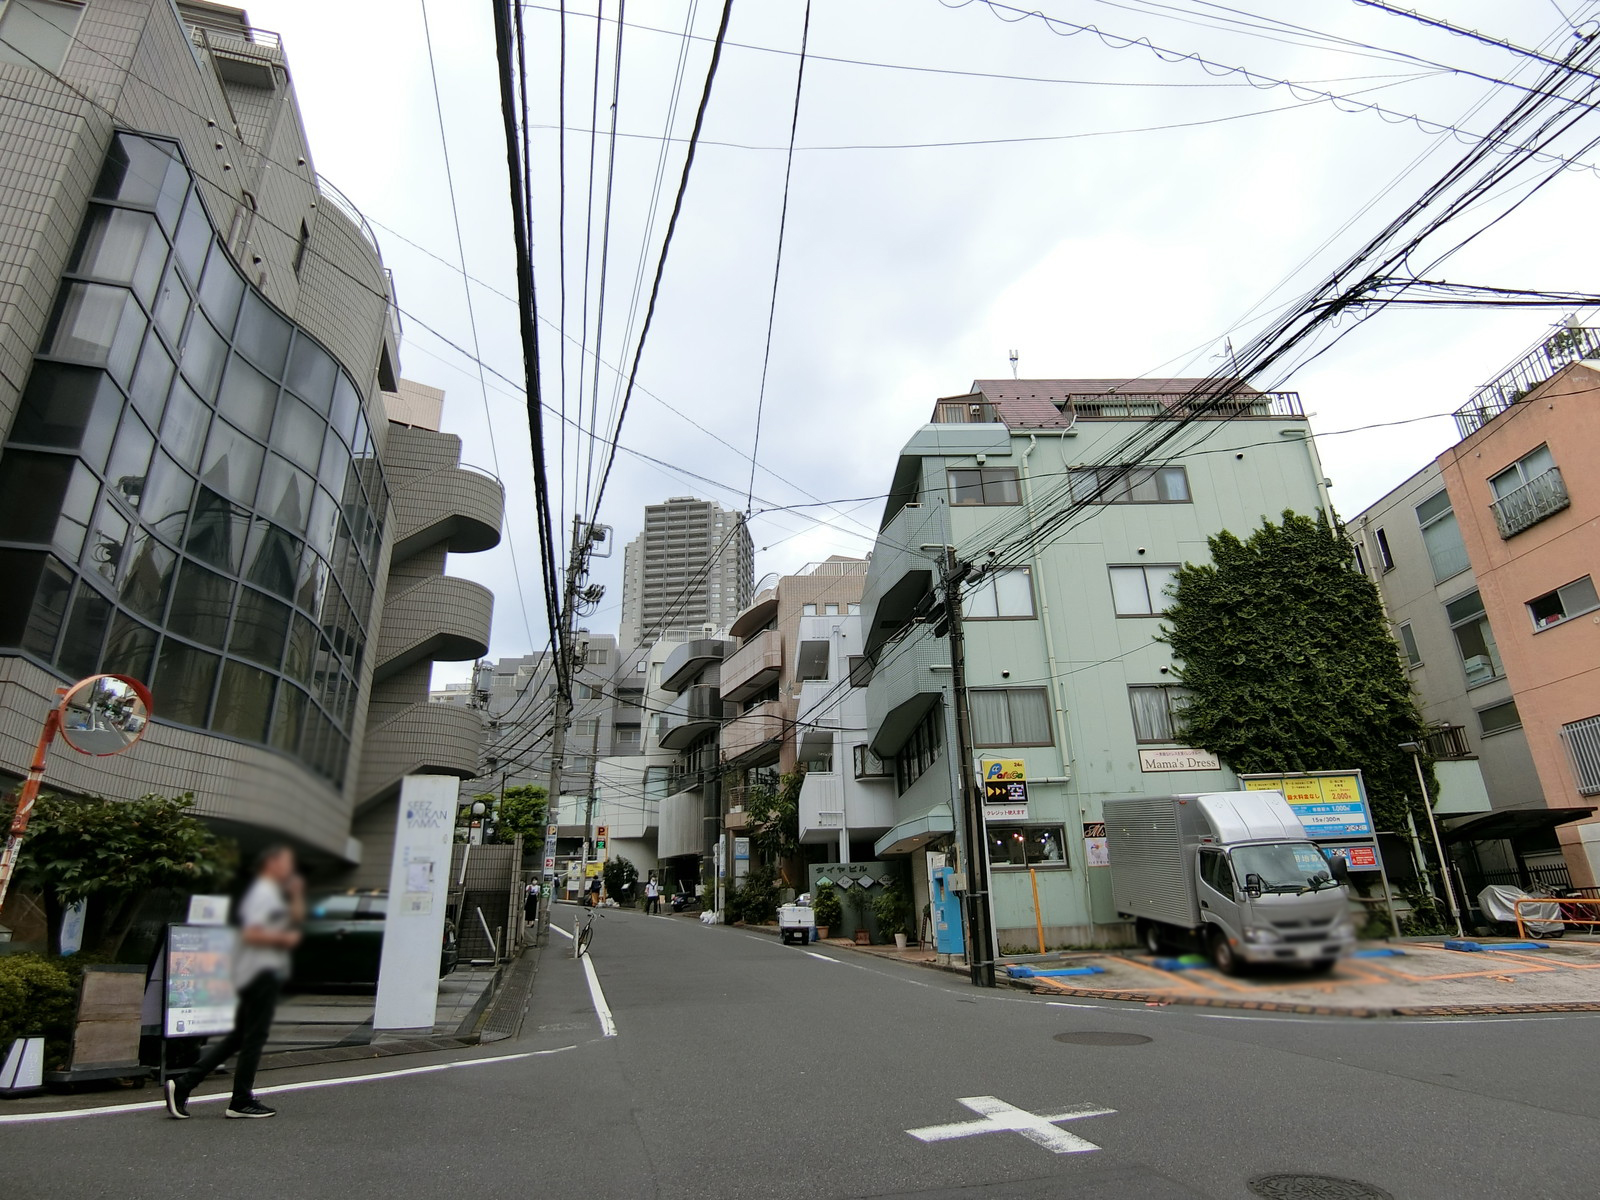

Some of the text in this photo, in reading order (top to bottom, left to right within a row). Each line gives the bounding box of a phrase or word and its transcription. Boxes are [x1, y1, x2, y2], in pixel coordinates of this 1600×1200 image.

[1145, 757, 1216, 769] Mama's Dress
[1007, 782, 1026, 800] 空
[408, 801, 432, 811] SEEZ
[406, 810, 447, 820] DAIKAN
[816, 865, 868, 874] ダイヤビル
